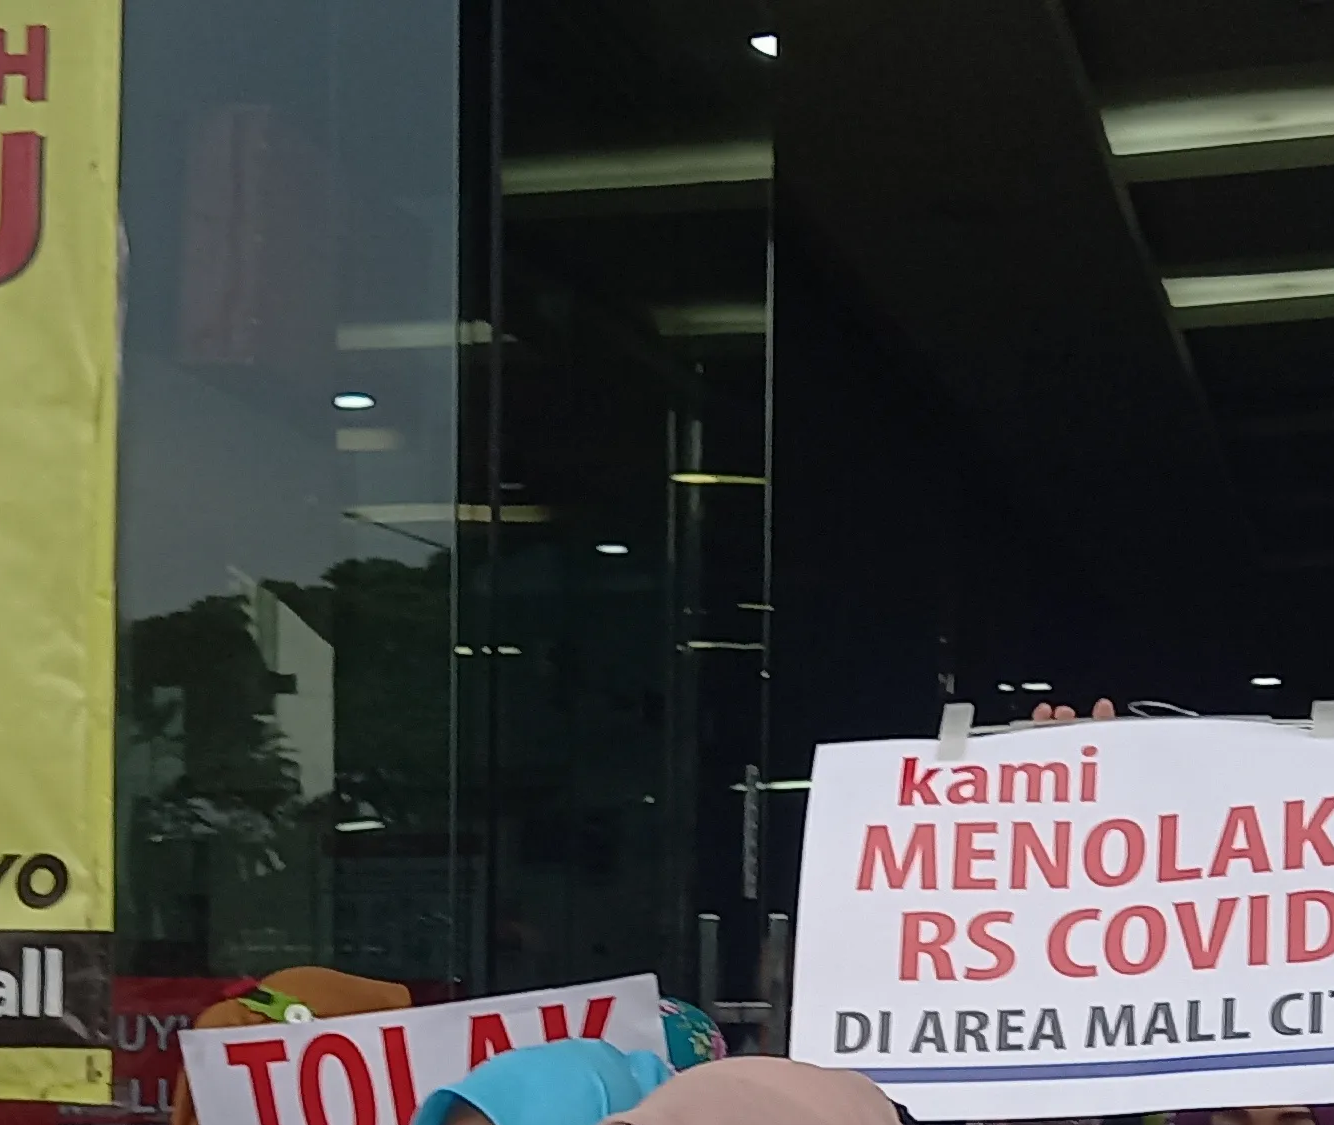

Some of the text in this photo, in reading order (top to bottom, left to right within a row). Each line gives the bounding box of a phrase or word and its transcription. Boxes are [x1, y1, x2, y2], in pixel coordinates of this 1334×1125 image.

[897, 745, 1098, 806] kami
[898, 911, 1017, 982] RS
[834, 1011, 892, 1054] DI
[909, 1009, 1066, 1053] AREA
[1084, 997, 1250, 1048] MALL
